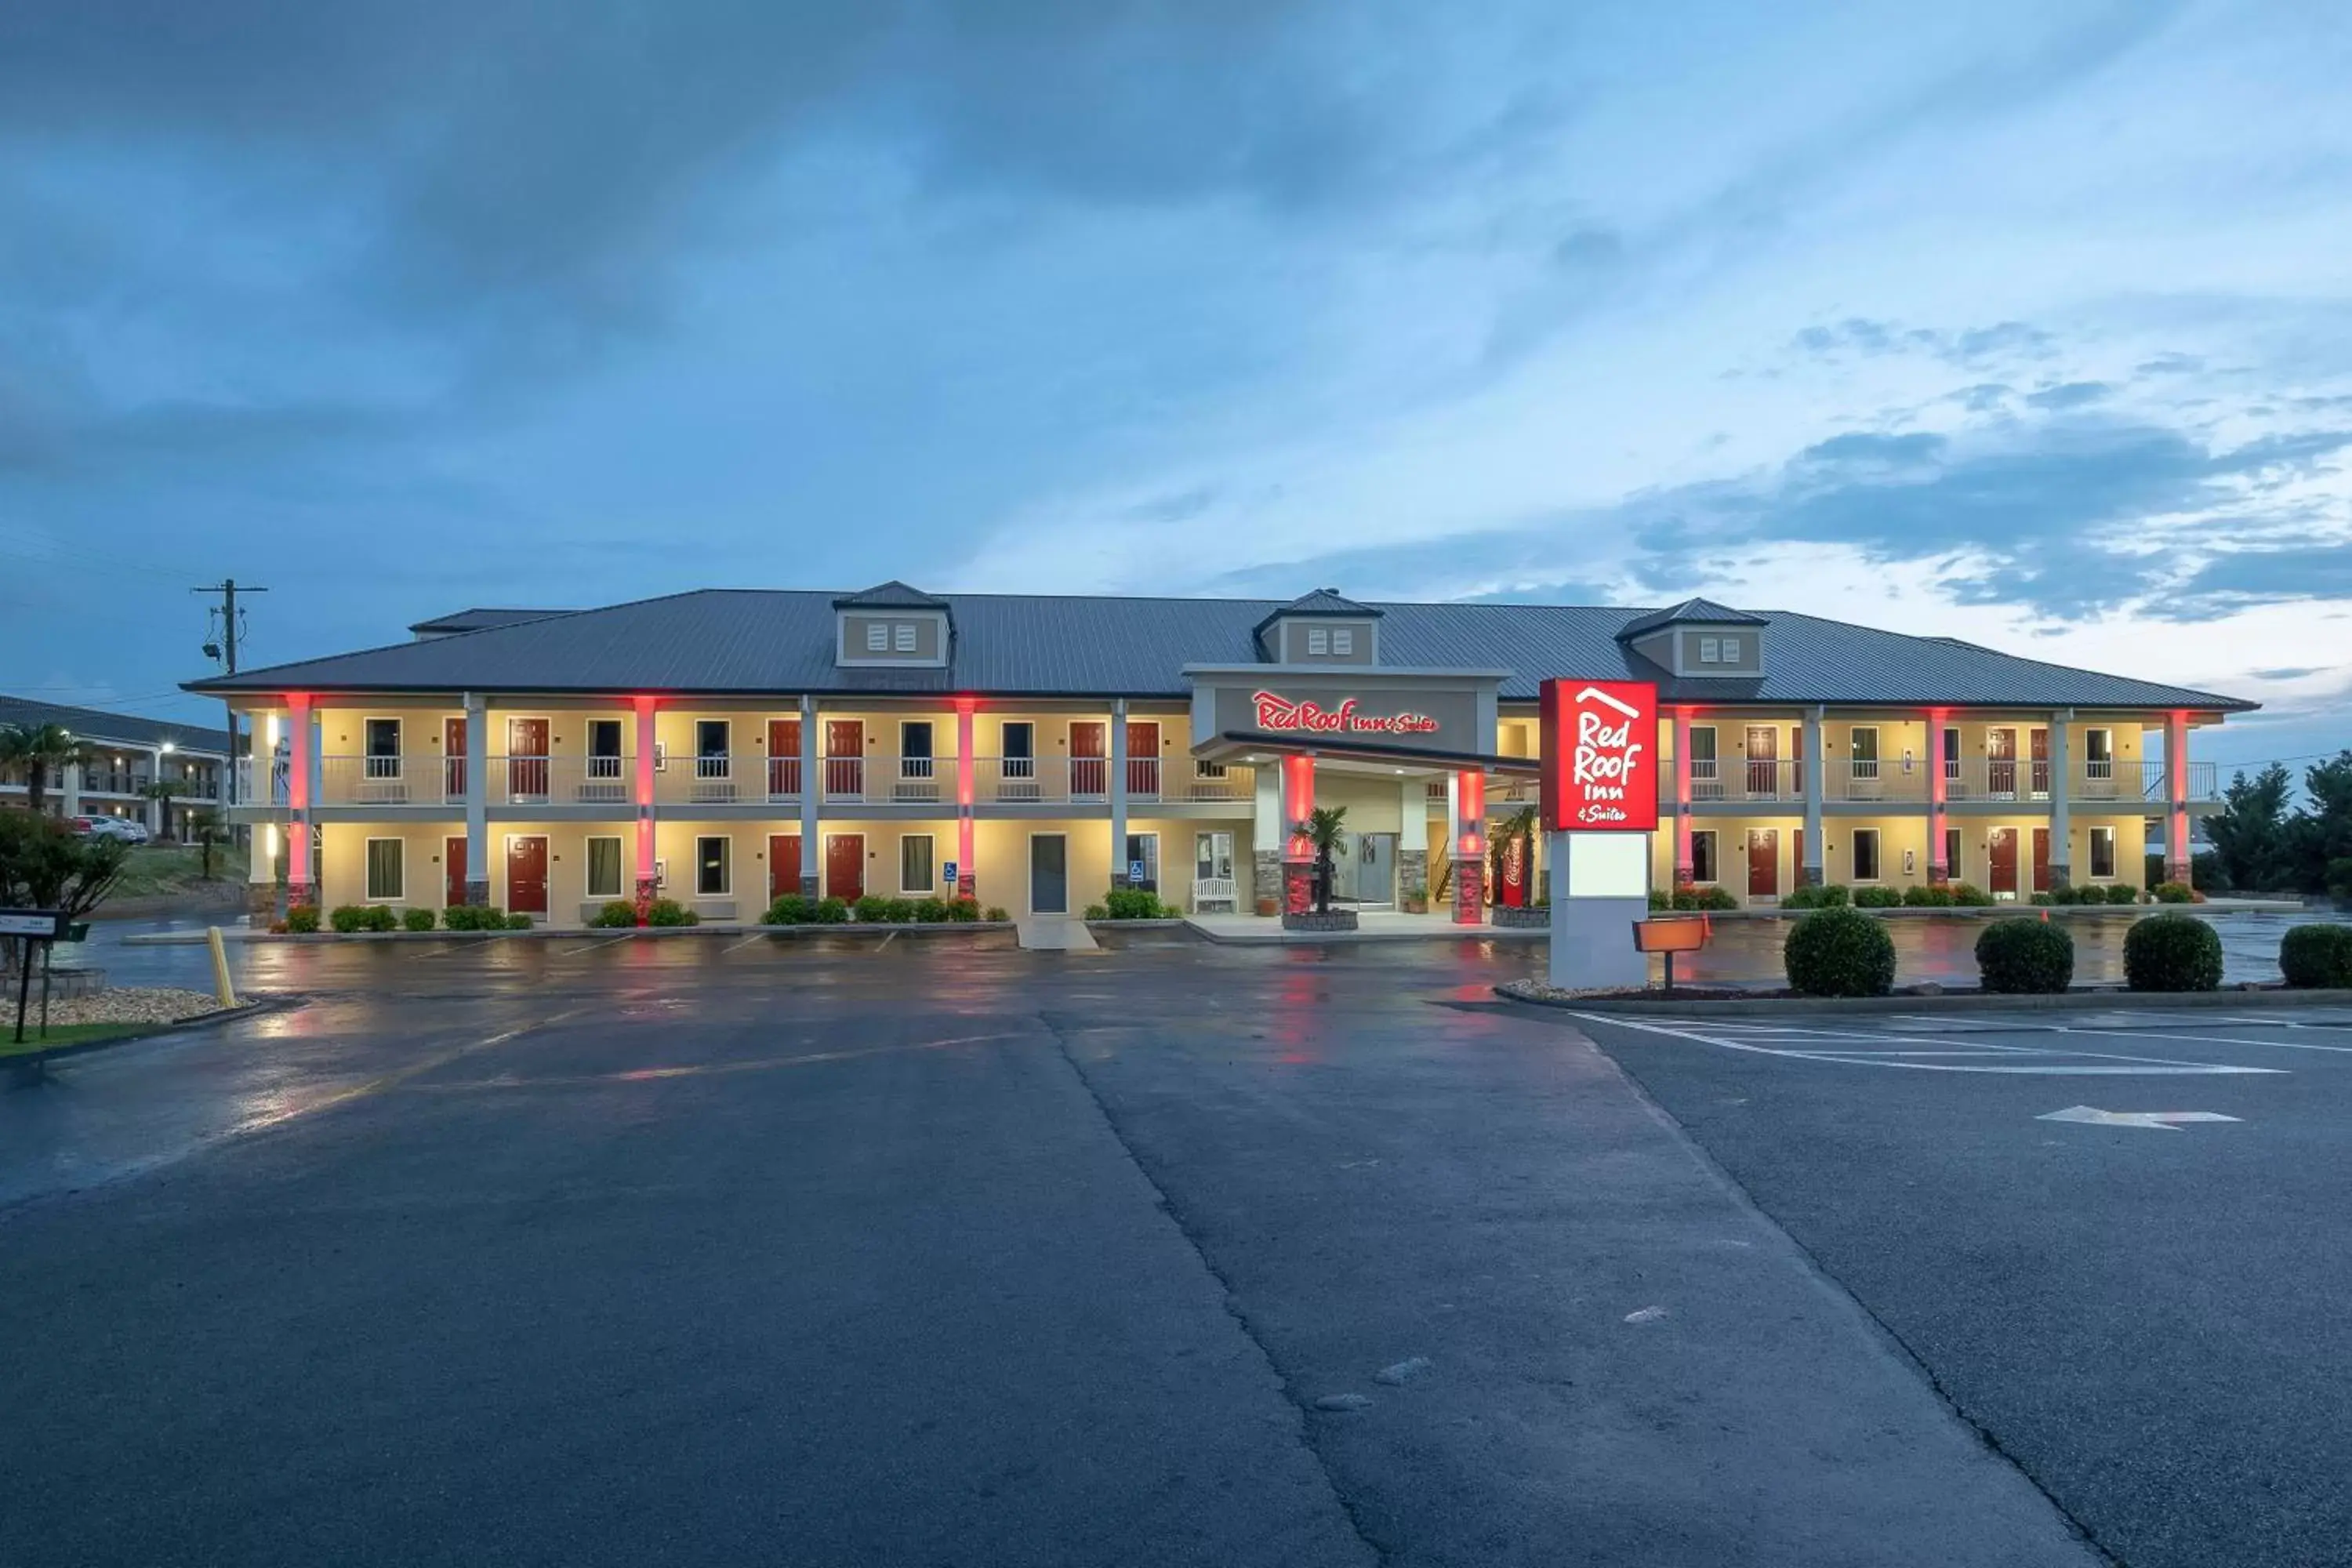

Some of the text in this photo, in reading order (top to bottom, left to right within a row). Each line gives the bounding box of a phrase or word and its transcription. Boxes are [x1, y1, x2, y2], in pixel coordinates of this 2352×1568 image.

[1258, 701, 1299, 729] Red
[1300, 698, 1358, 731] Roof
[1352, 716, 1386, 731] Inn
[1579, 711, 1631, 749] Red
[1573, 744, 1642, 786] Roof
[1584, 783, 1624, 801] Inn
